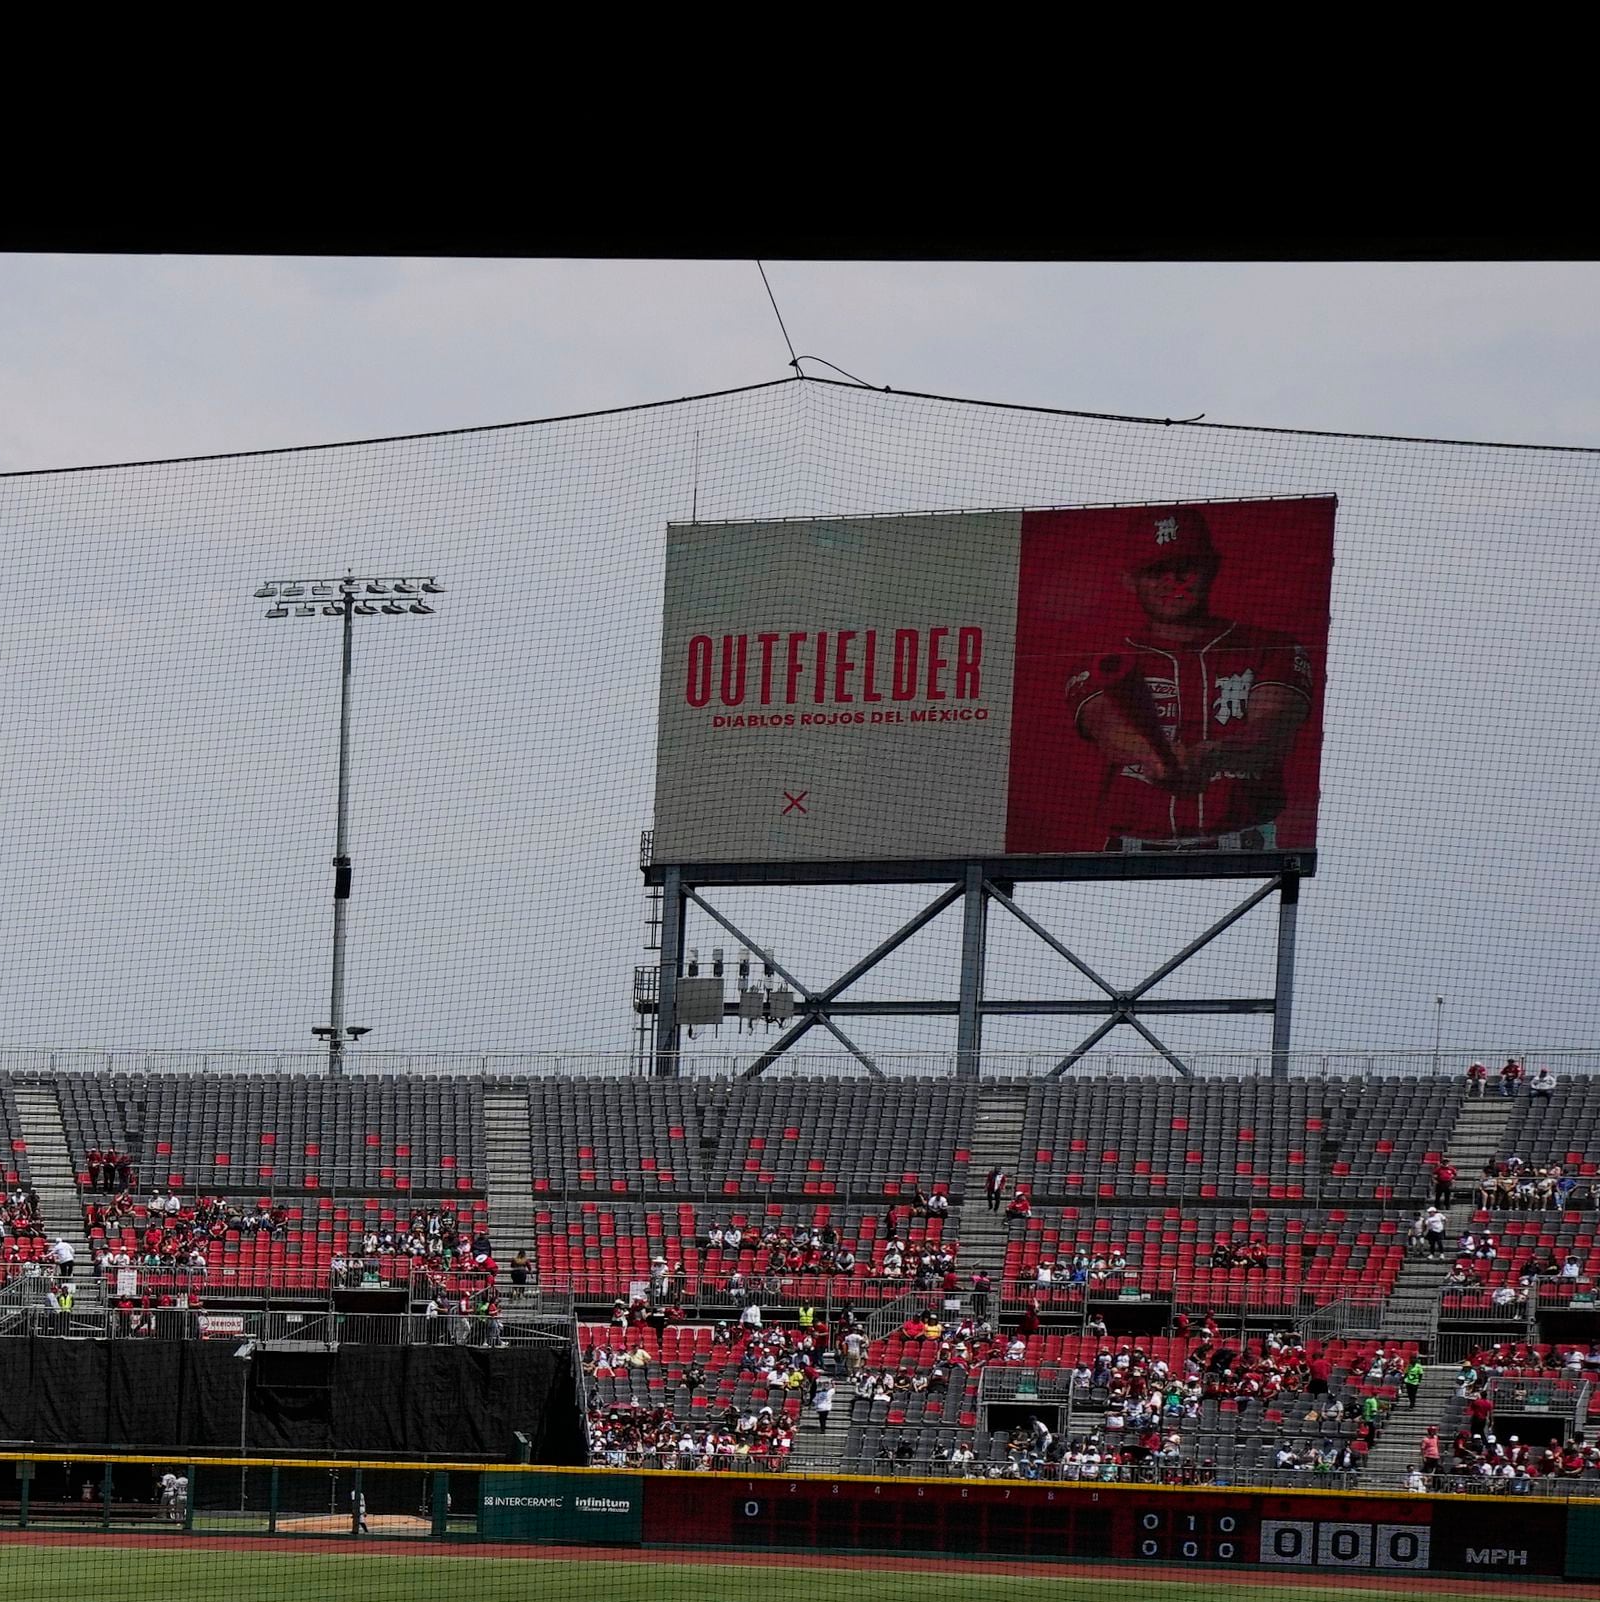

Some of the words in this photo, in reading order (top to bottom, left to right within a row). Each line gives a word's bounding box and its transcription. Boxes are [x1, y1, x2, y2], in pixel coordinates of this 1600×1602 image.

[686, 626, 983, 708] OUTFIELDER
[712, 714, 795, 728] DIABLOS
[800, 710, 865, 726] ROJOS
[870, 710, 905, 724] DEL
[909, 705, 989, 723] MÉXICO
[495, 1497, 563, 1508] INTERCERAMIC
[576, 1497, 630, 1508] infinitum
[745, 1502, 759, 1516] 0
[1143, 1513, 1159, 1529] 0
[1187, 1515, 1195, 1531] 1
[1220, 1516, 1236, 1532] 0
[1142, 1539, 1158, 1555] 0
[1183, 1541, 1198, 1557] 0
[1218, 1543, 1234, 1559] 0
[1274, 1527, 1301, 1557] 0
[1331, 1529, 1360, 1560] 0
[1389, 1531, 1419, 1562] 0
[1465, 1547, 1528, 1566] MPH
